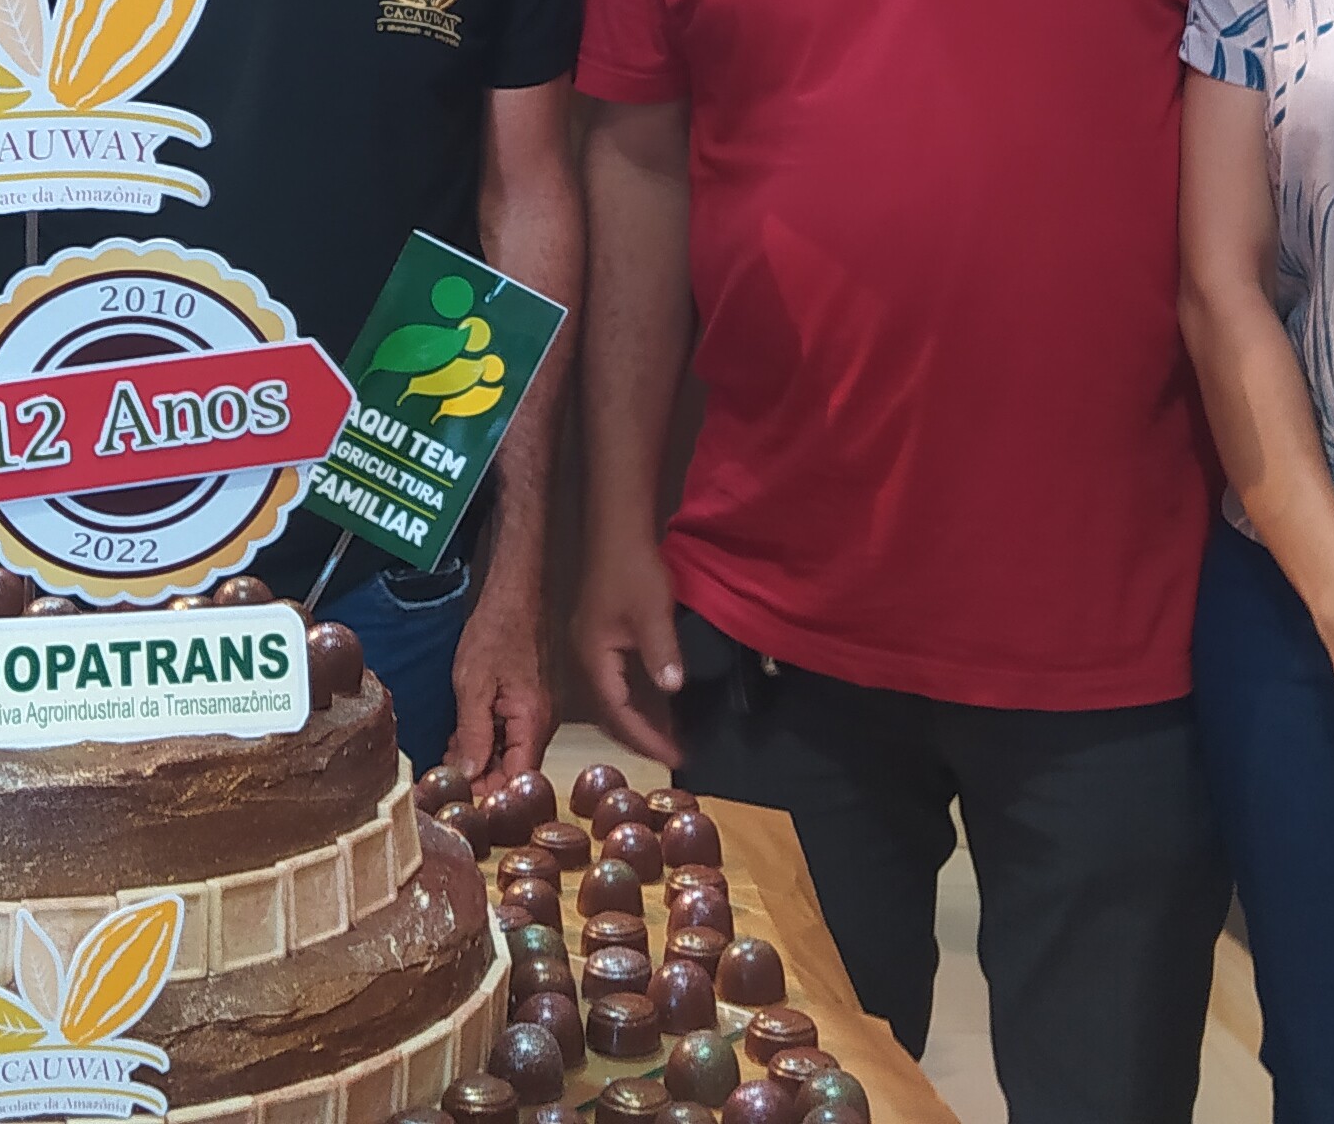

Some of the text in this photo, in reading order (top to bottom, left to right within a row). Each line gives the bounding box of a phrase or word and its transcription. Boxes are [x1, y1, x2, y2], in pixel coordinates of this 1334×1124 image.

[384, 6, 458, 33] CACAUWAY
[32, 186, 55, 205] da
[59, 184, 153, 207] Amazônia
[99, 285, 197, 320] 2010
[94, 379, 291, 457] Anos
[346, 402, 467, 481] AQUI TEM
[309, 466, 430, 548] FAMILIAR
[68, 531, 160, 564] 2022
[25, 696, 132, 729] Agroindustrial
[133, 696, 161, 720] da
[166, 687, 292, 718] Transamazônica
